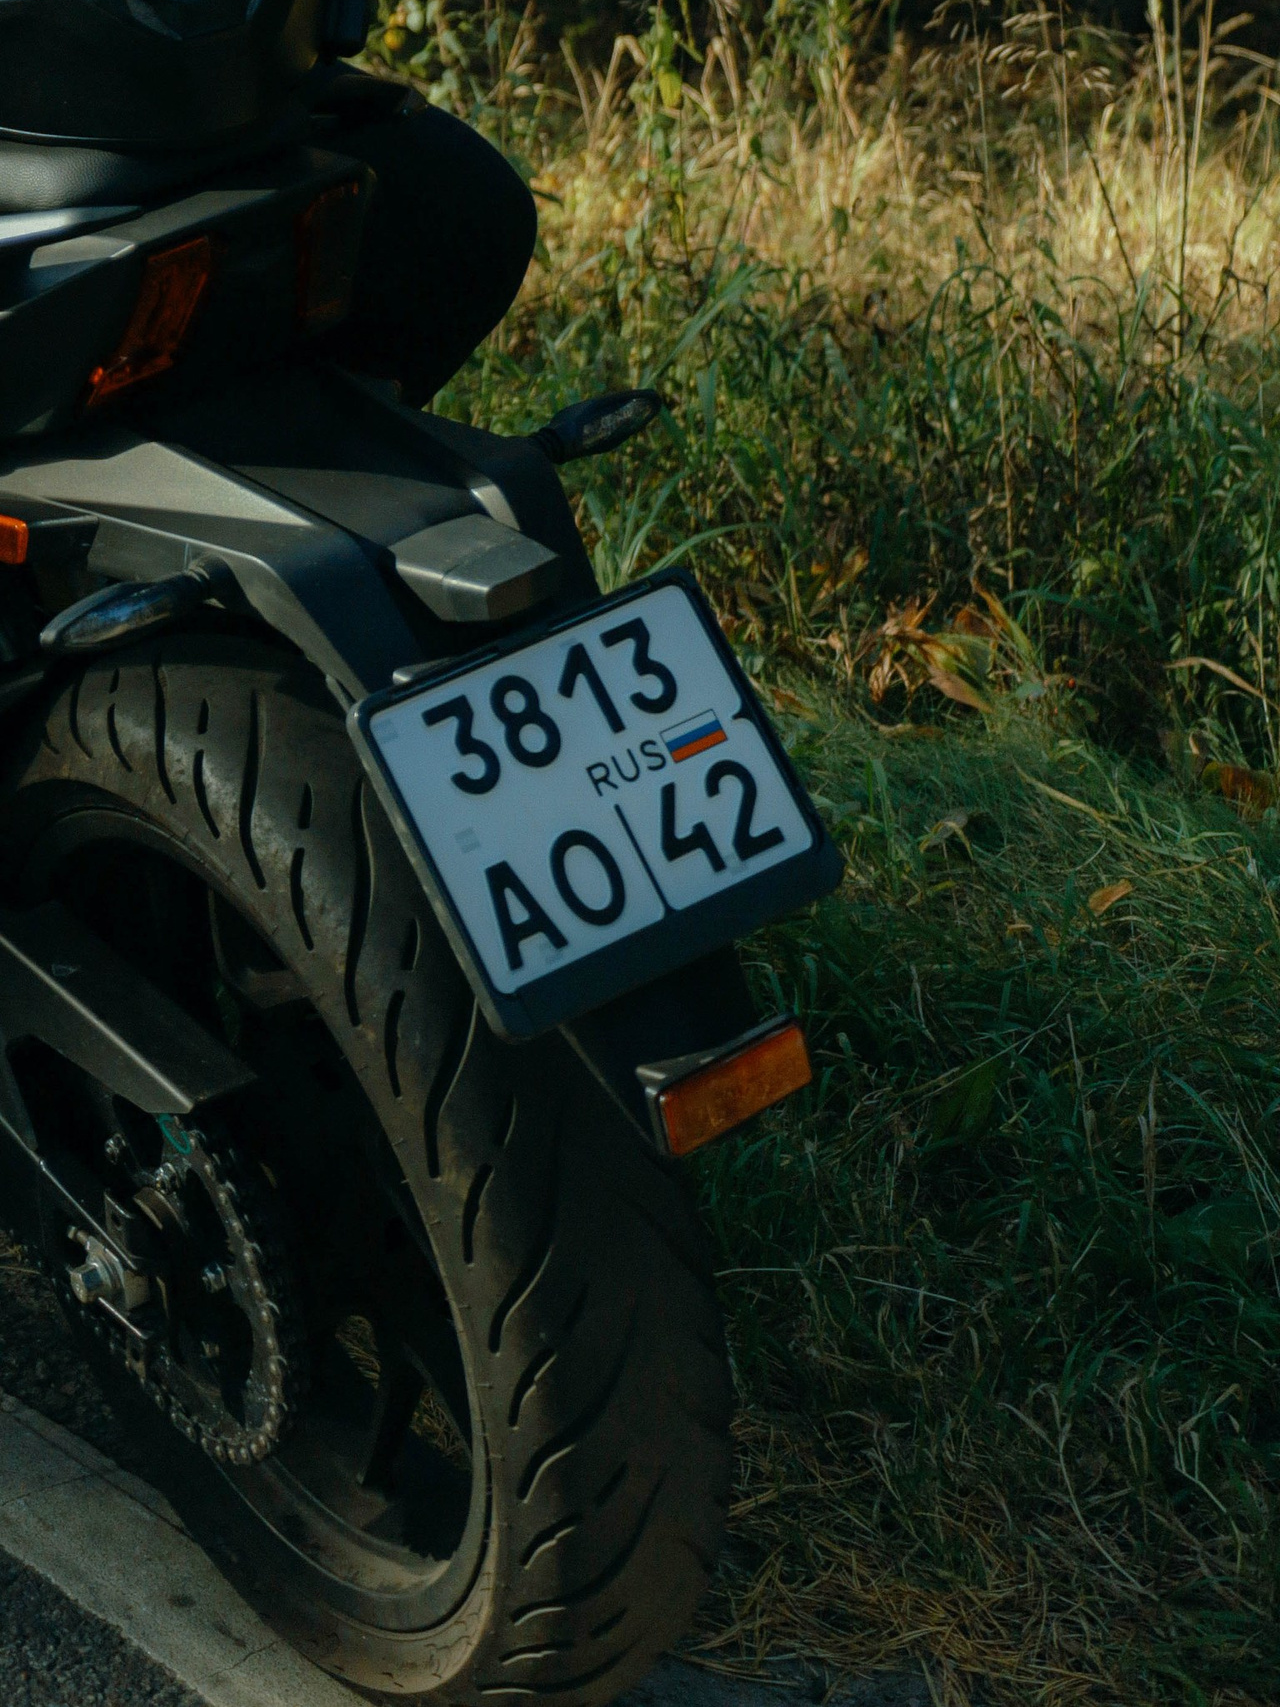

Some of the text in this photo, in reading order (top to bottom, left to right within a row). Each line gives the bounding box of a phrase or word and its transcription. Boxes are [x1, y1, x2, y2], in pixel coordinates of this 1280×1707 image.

[422, 617, 678, 795] 3813
[586, 739, 667, 796] RUS
[660, 760, 785, 873] 42
